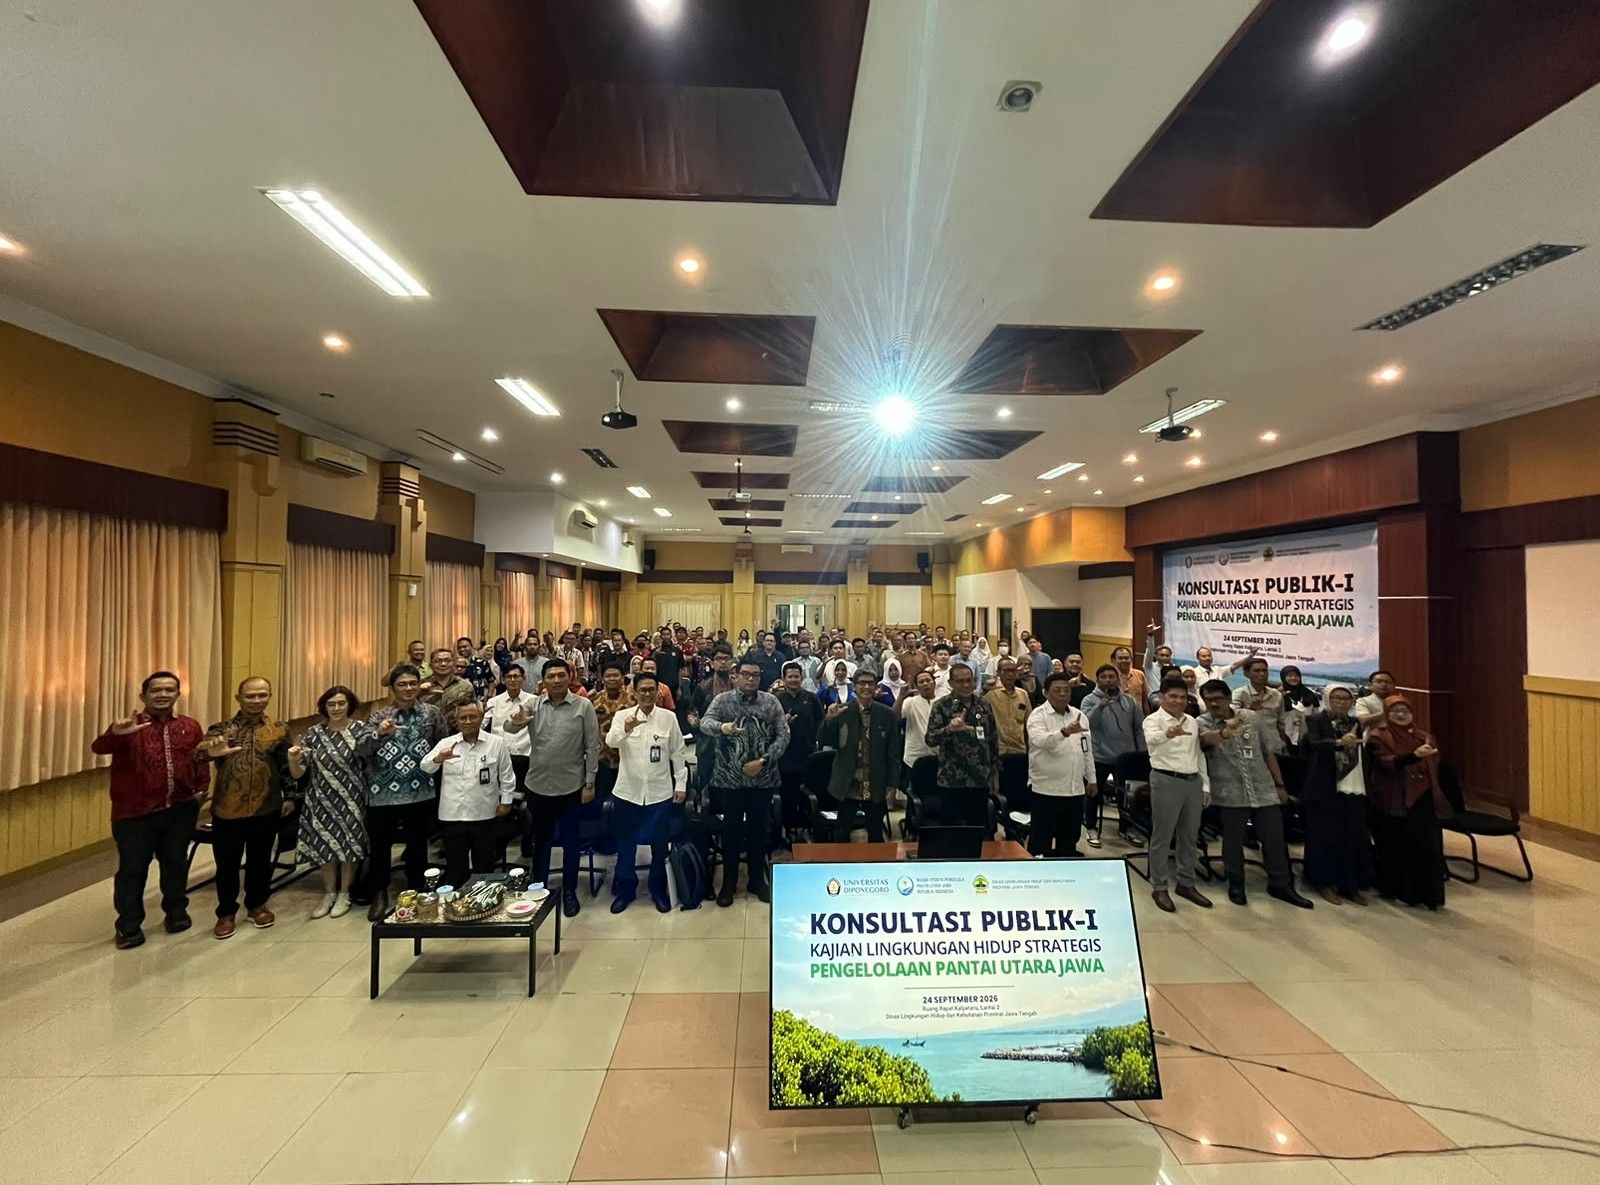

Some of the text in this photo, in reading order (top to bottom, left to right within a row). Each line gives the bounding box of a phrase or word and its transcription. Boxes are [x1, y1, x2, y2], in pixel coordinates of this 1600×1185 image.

[1178, 574, 1354, 596] KONSULTASI PUBLIK-I
[1177, 599, 1354, 610] KAJIAN LINGKUNGAN HIDUP STRATEGIS
[1177, 612, 1354, 629] PENGELOLAAN PANTAI UTARA JAWA
[810, 910, 1098, 934] KONSULTASI PUBLIK-I
[810, 938, 1102, 960] KAJIAN LINGKUNGAN HIDUP STRATEGIS
[810, 958, 1105, 978] PENGELOLAAN PANTAI UTARA JAWA
[934, 995, 978, 1003] SEPTEMBER
